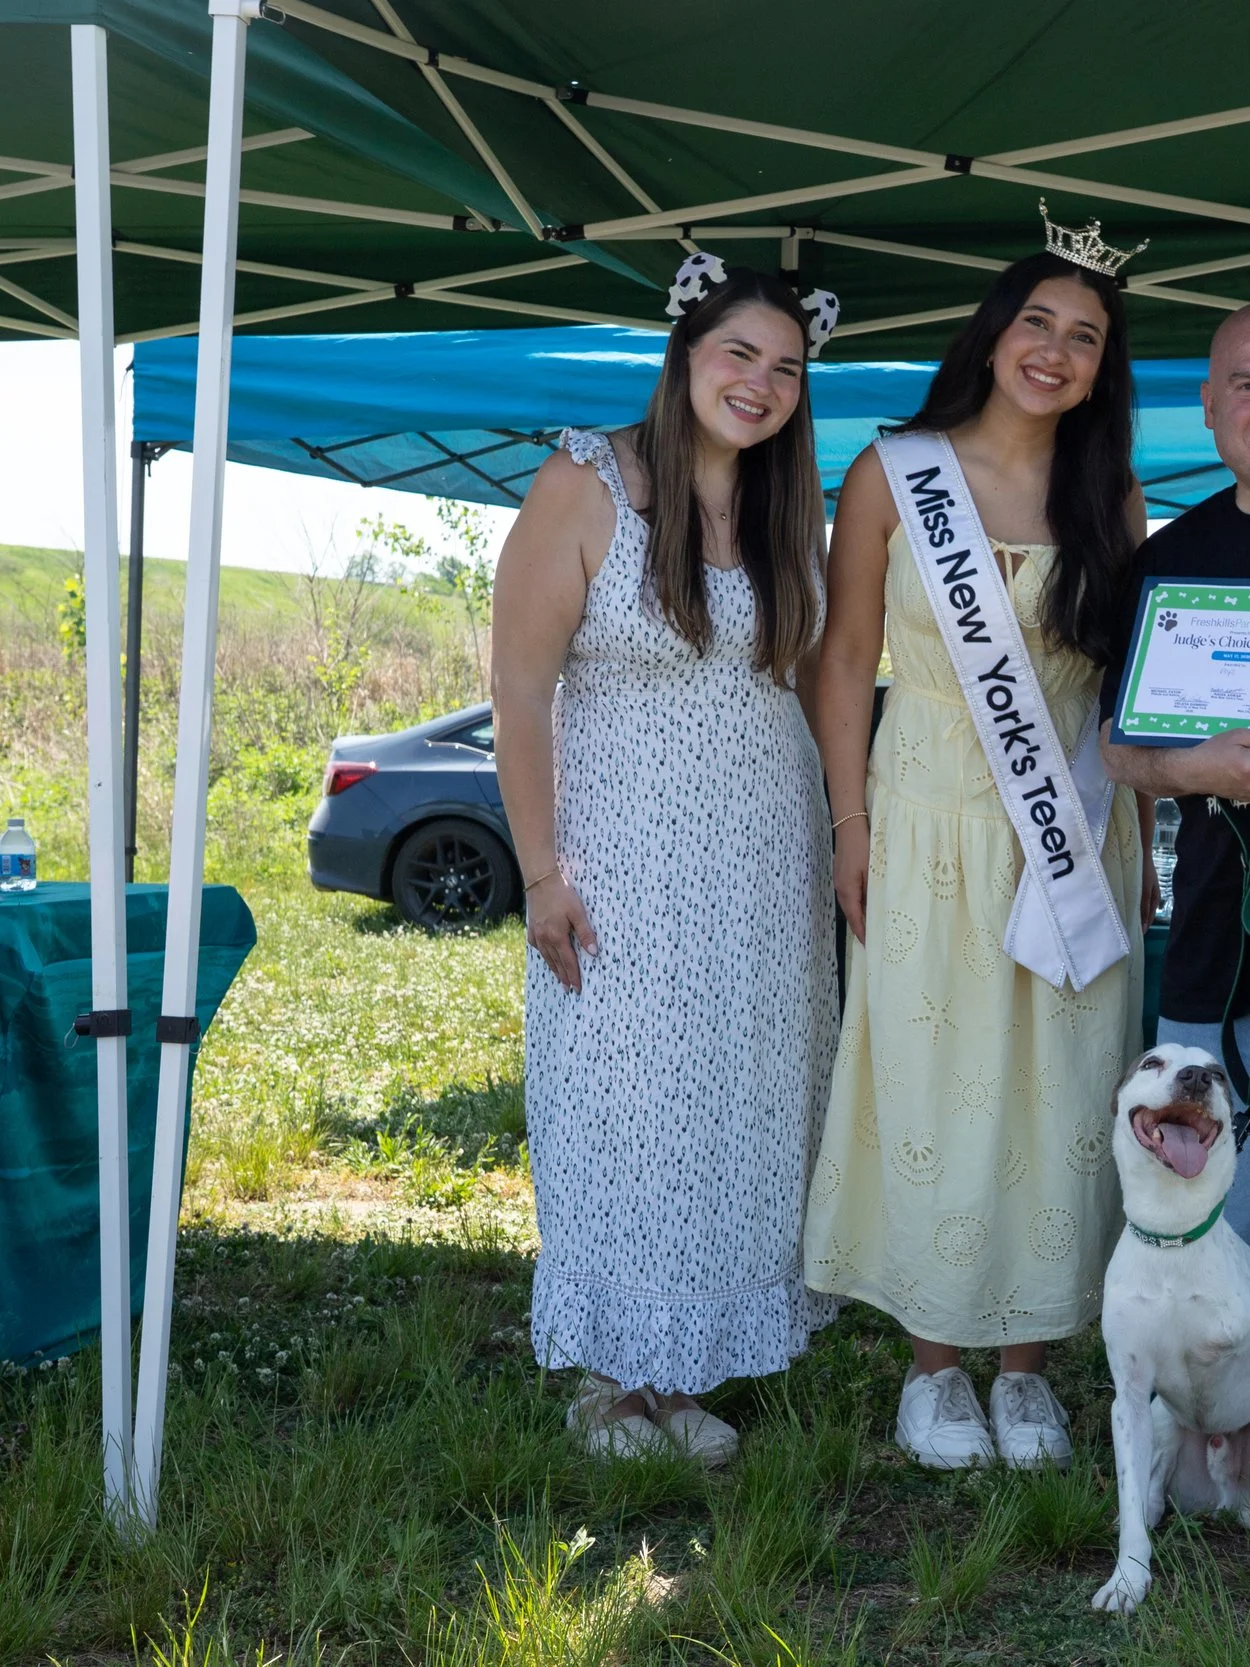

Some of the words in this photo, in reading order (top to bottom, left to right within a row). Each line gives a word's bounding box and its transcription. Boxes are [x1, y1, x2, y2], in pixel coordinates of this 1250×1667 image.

[906, 465, 955, 550] Miss
[936, 548, 992, 645] New
[977, 654, 1036, 777] York's
[1021, 776, 1075, 881] Teen
[1173, 633, 1216, 650] Judge's
